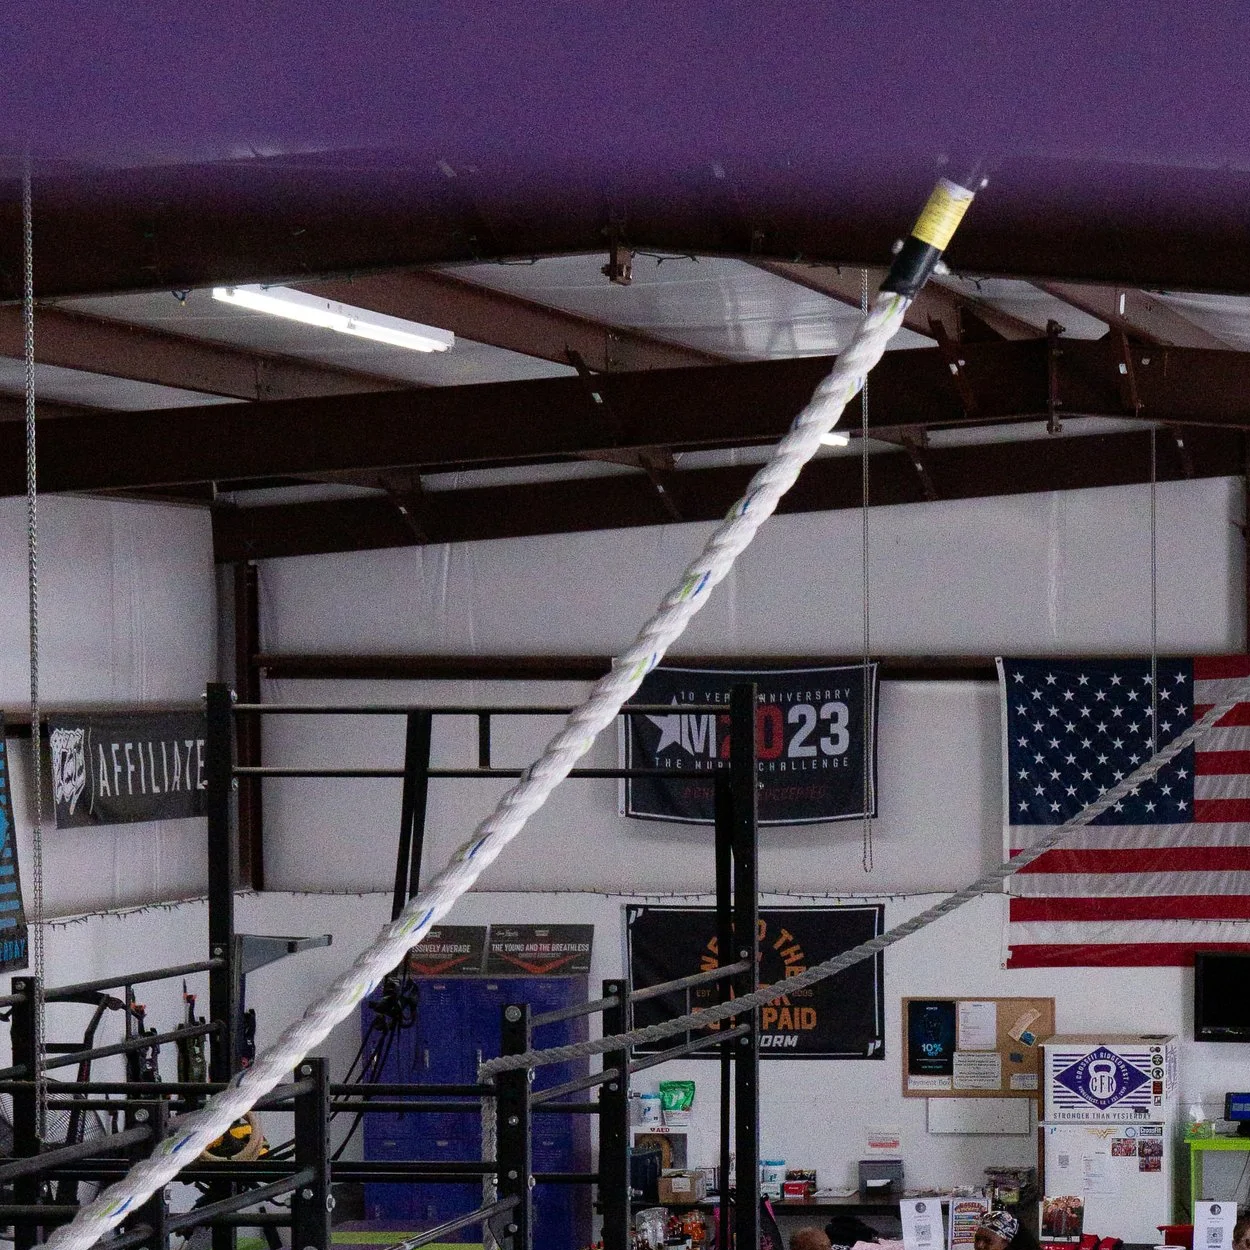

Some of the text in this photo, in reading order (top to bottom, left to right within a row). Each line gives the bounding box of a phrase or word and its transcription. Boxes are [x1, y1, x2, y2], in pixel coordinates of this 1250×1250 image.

[681, 691, 695, 701] 10
[758, 688, 851, 703] NNIVERSARY
[98, 739, 209, 798] AFFILIATE
[655, 757, 682, 769] THE
[758, 757, 849, 772] CHALLENGE
[441, 944, 471, 953] AVERAGE
[492, 943, 590, 952] THE YOUNG AND THE BREATHLESS
[762, 1007, 817, 1030] PAID
[921, 1043, 943, 1053] 10%
[1075, 1052, 1130, 1081] CROSSFIT RIDGECREST
[1091, 1075, 1114, 1094] CFR
[1053, 1111, 1152, 1120] STRONGER THAN YESTERDAY
